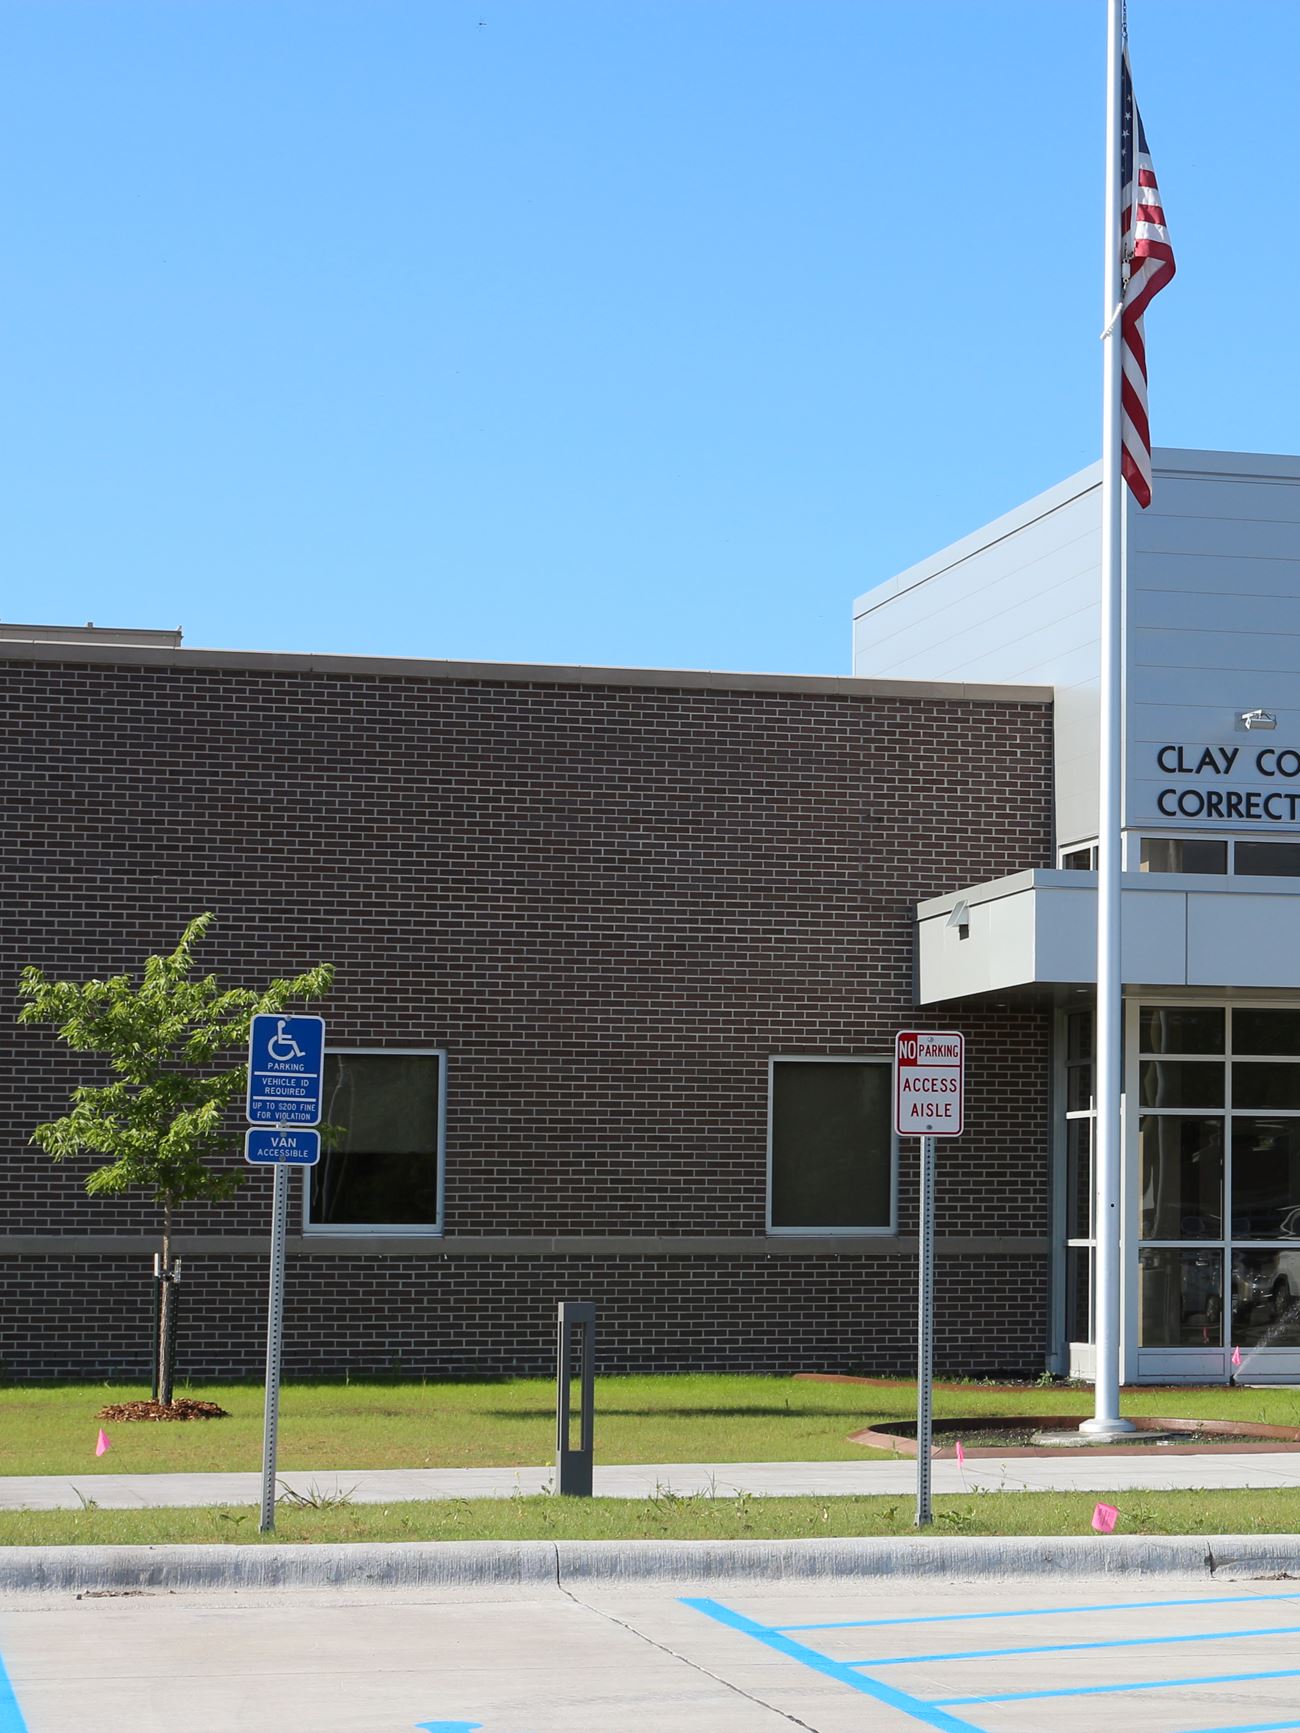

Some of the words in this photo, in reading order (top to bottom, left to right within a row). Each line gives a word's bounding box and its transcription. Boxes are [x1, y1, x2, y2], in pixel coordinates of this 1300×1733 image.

[1157, 745, 1239, 775] CLAY
[899, 1040, 916, 1059] NO
[919, 1044, 959, 1057] PARKING
[268, 1062, 304, 1071] PARKING
[262, 1077, 296, 1087] VEHICLE
[300, 1078, 309, 1087] ID
[903, 1078, 957, 1092] ACCESS
[264, 1086, 306, 1096] REQUIRED
[252, 1101, 262, 1109] UP
[266, 1102, 275, 1110] TO
[300, 1103, 316, 1112] FINE
[911, 1103, 952, 1117] AISLE
[256, 1110, 271, 1119] FOR
[274, 1111, 311, 1120] VIOLATION
[270, 1137, 297, 1148] VAN
[257, 1148, 308, 1158] ACCESSIBLE
